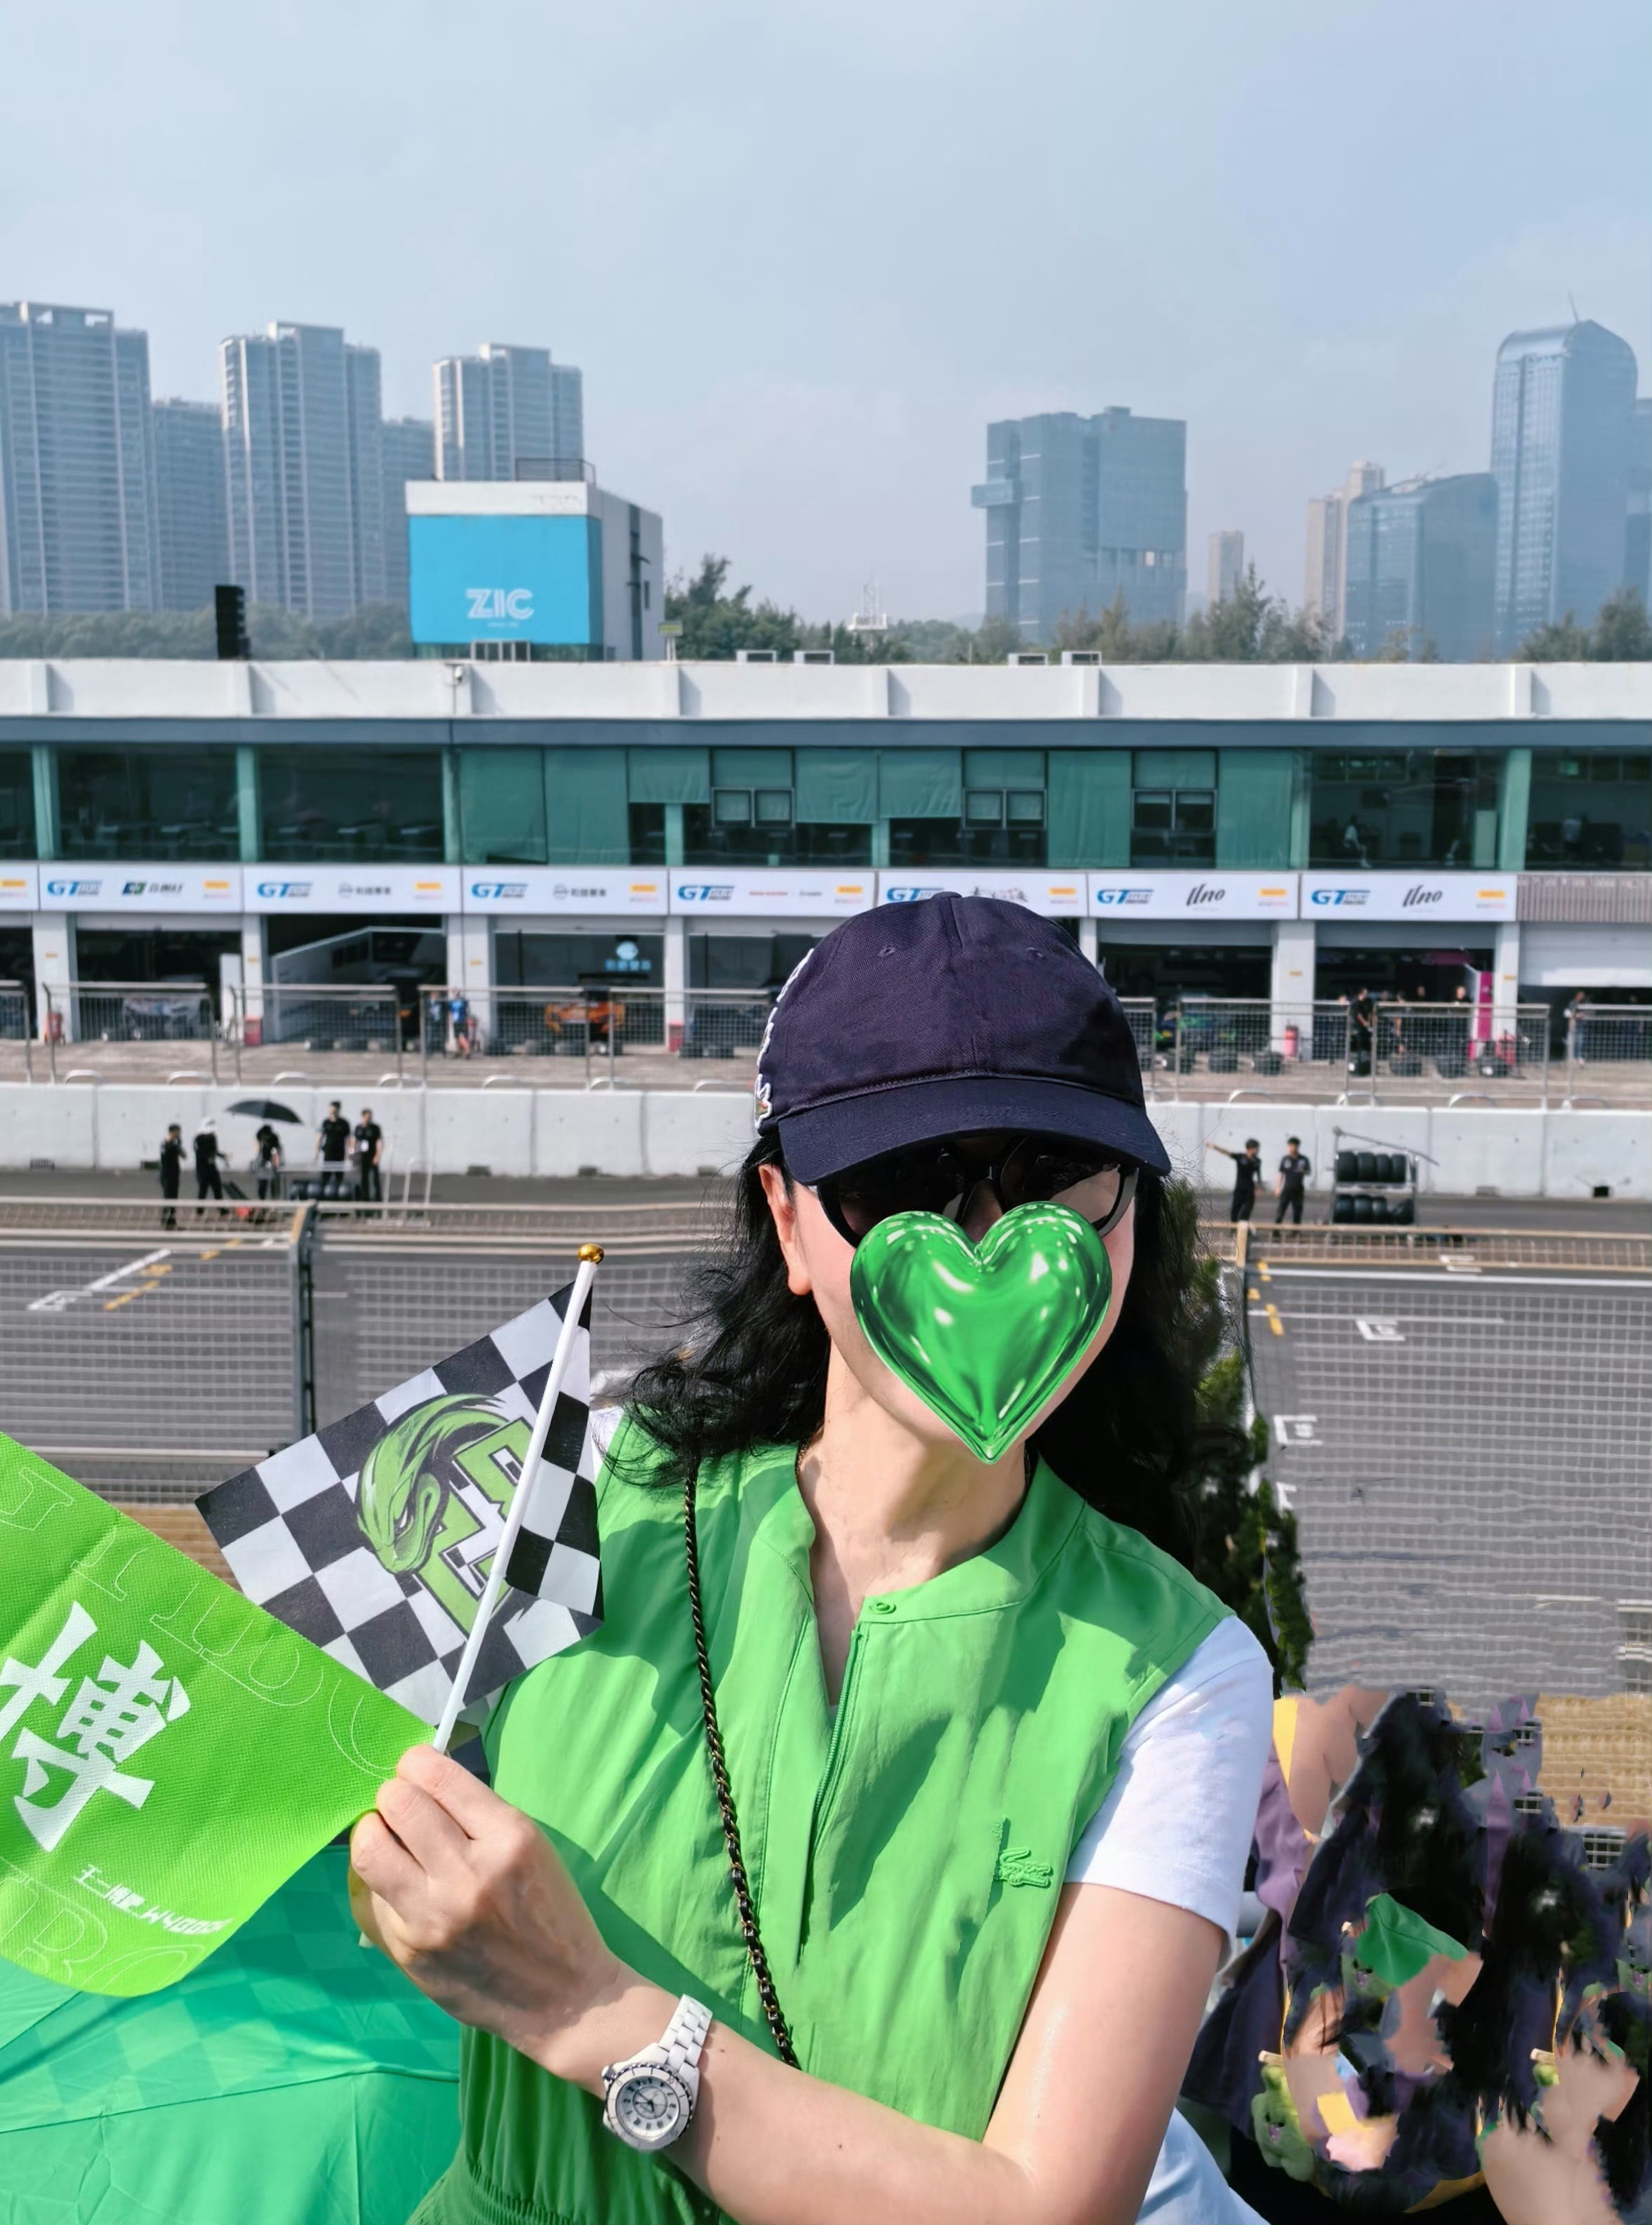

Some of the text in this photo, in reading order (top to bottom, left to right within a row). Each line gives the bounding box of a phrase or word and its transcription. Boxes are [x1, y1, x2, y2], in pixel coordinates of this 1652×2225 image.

[465, 587, 535, 620] ZIC
[1097, 889, 1138, 904] GT
[1312, 889, 1353, 905] GT
